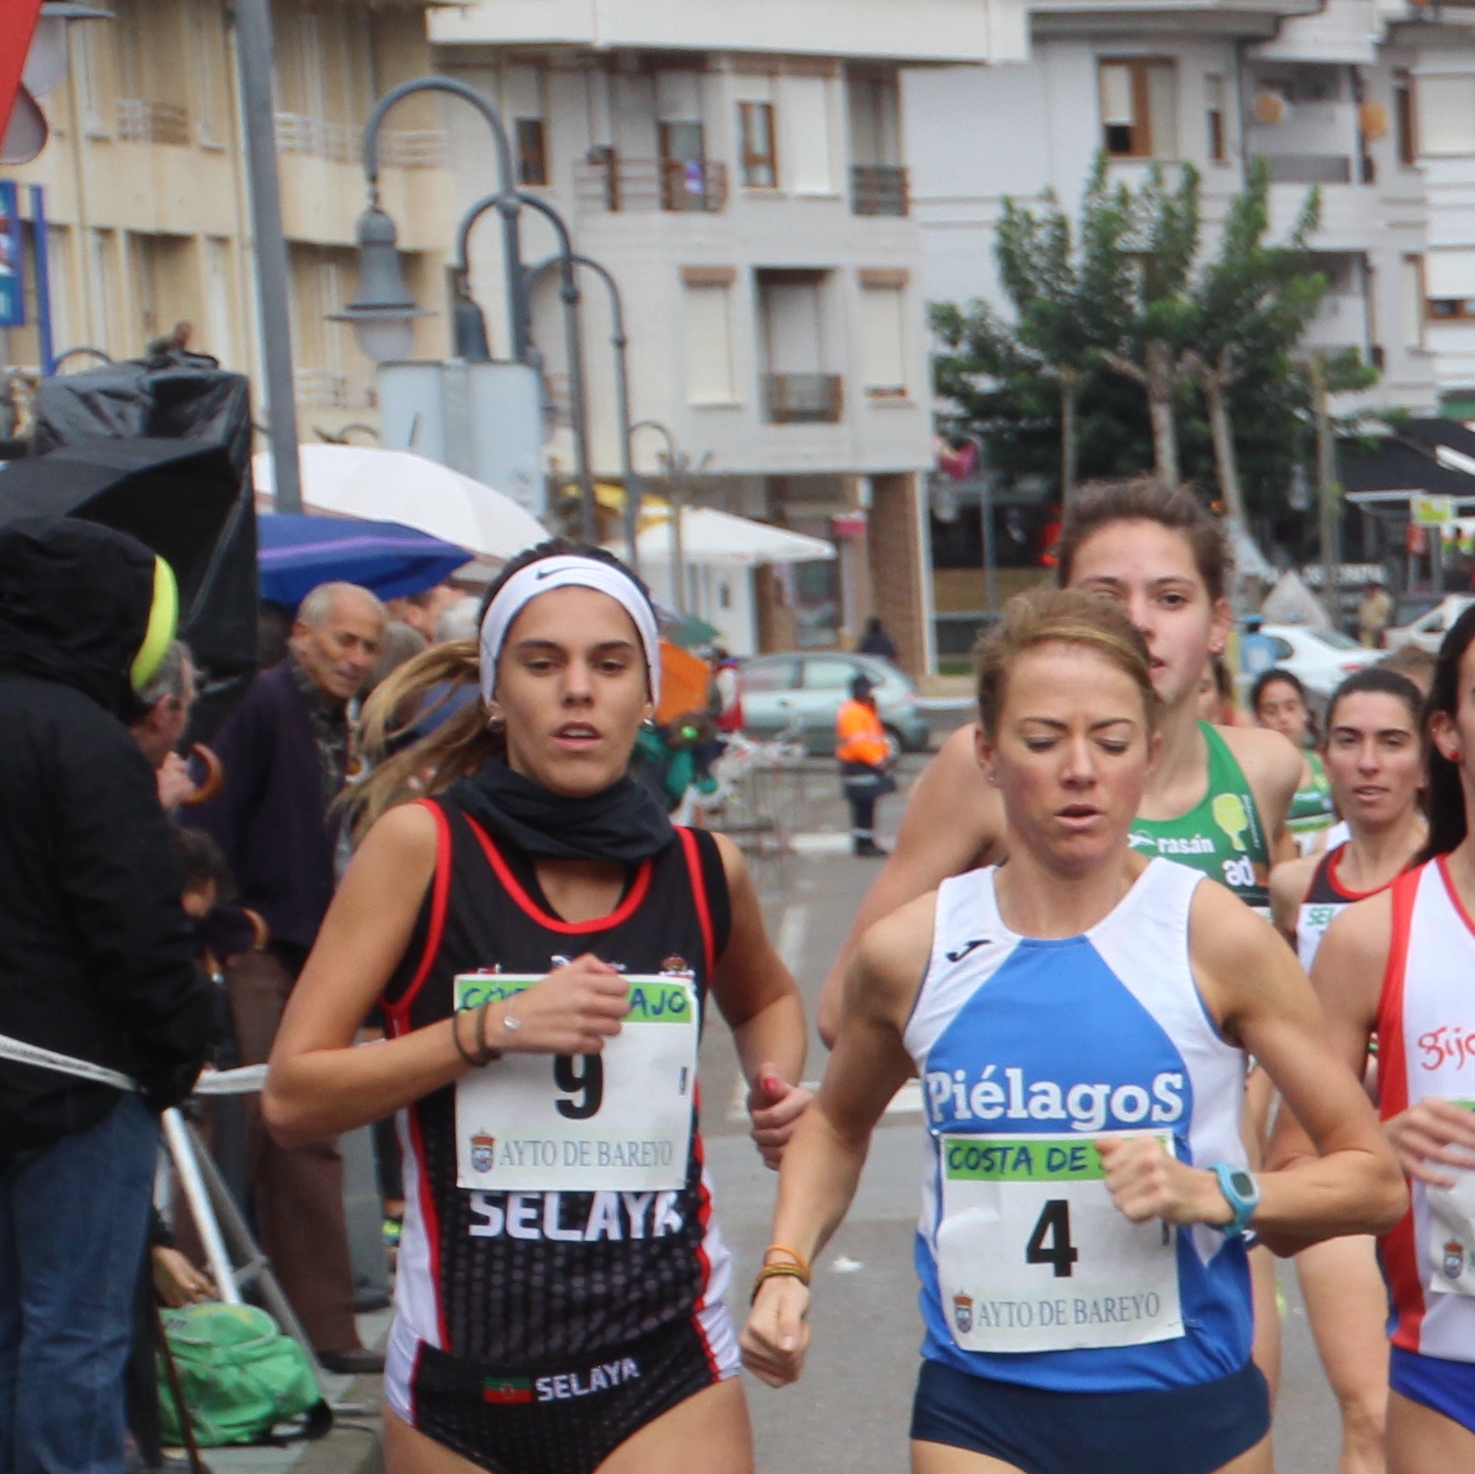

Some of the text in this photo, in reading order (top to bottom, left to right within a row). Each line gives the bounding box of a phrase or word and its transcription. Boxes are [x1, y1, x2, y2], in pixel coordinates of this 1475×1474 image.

[630, 987, 687, 1017] AJO
[553, 1052, 605, 1120] 9
[925, 1063, 1184, 1132] PiélagoS
[499, 1139, 673, 1168] AYTO DE BAREYO
[949, 1145, 1088, 1176] COSTA DE
[1025, 1198, 1079, 1278] 4
[977, 1291, 1161, 1329] AYTO DE BAREYO
[535, 1357, 641, 1402] SELAYA
